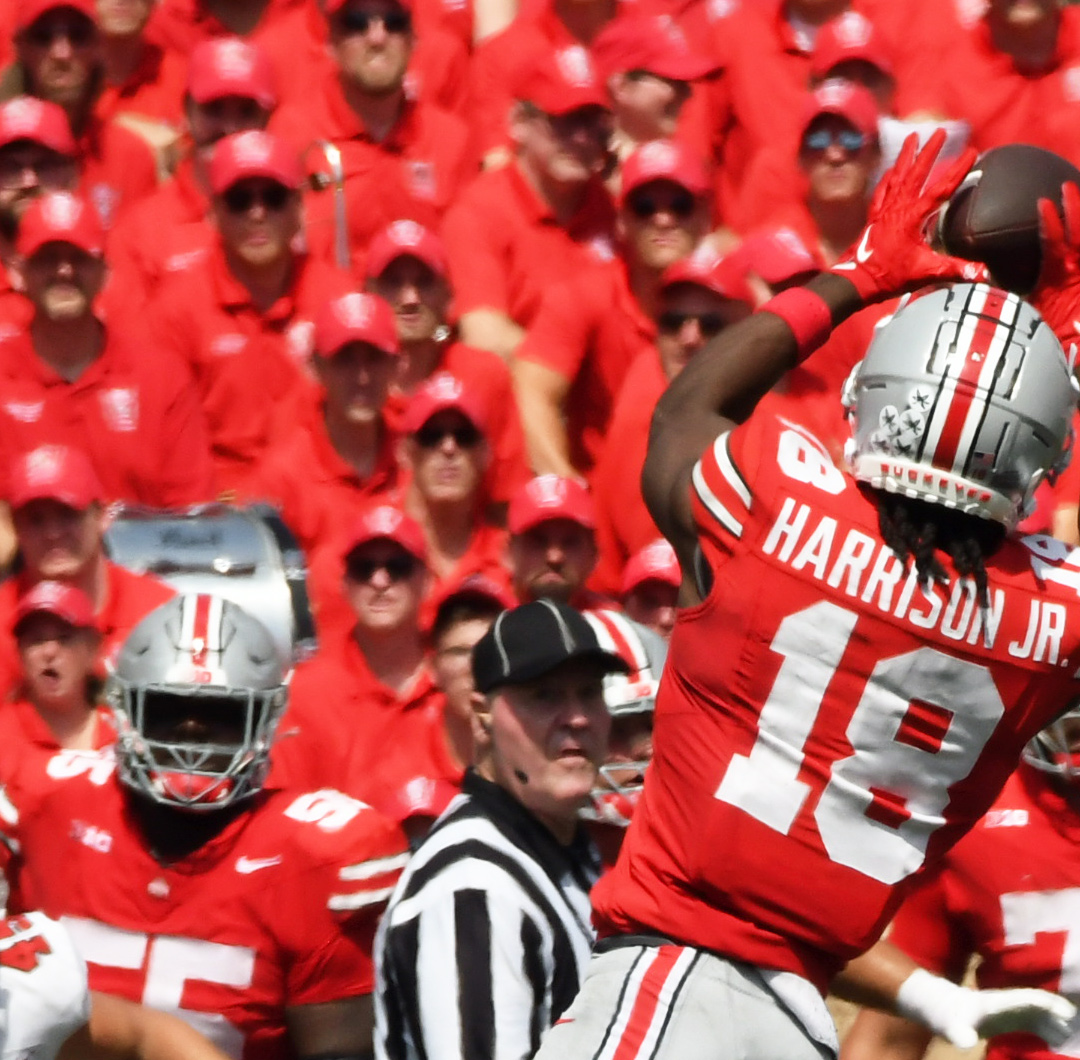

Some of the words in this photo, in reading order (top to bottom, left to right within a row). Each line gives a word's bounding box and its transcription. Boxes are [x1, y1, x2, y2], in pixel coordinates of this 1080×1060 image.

[761, 496, 1005, 650] HARRISON
[1007, 599, 1069, 668] JR.
[713, 599, 1006, 886] 18
